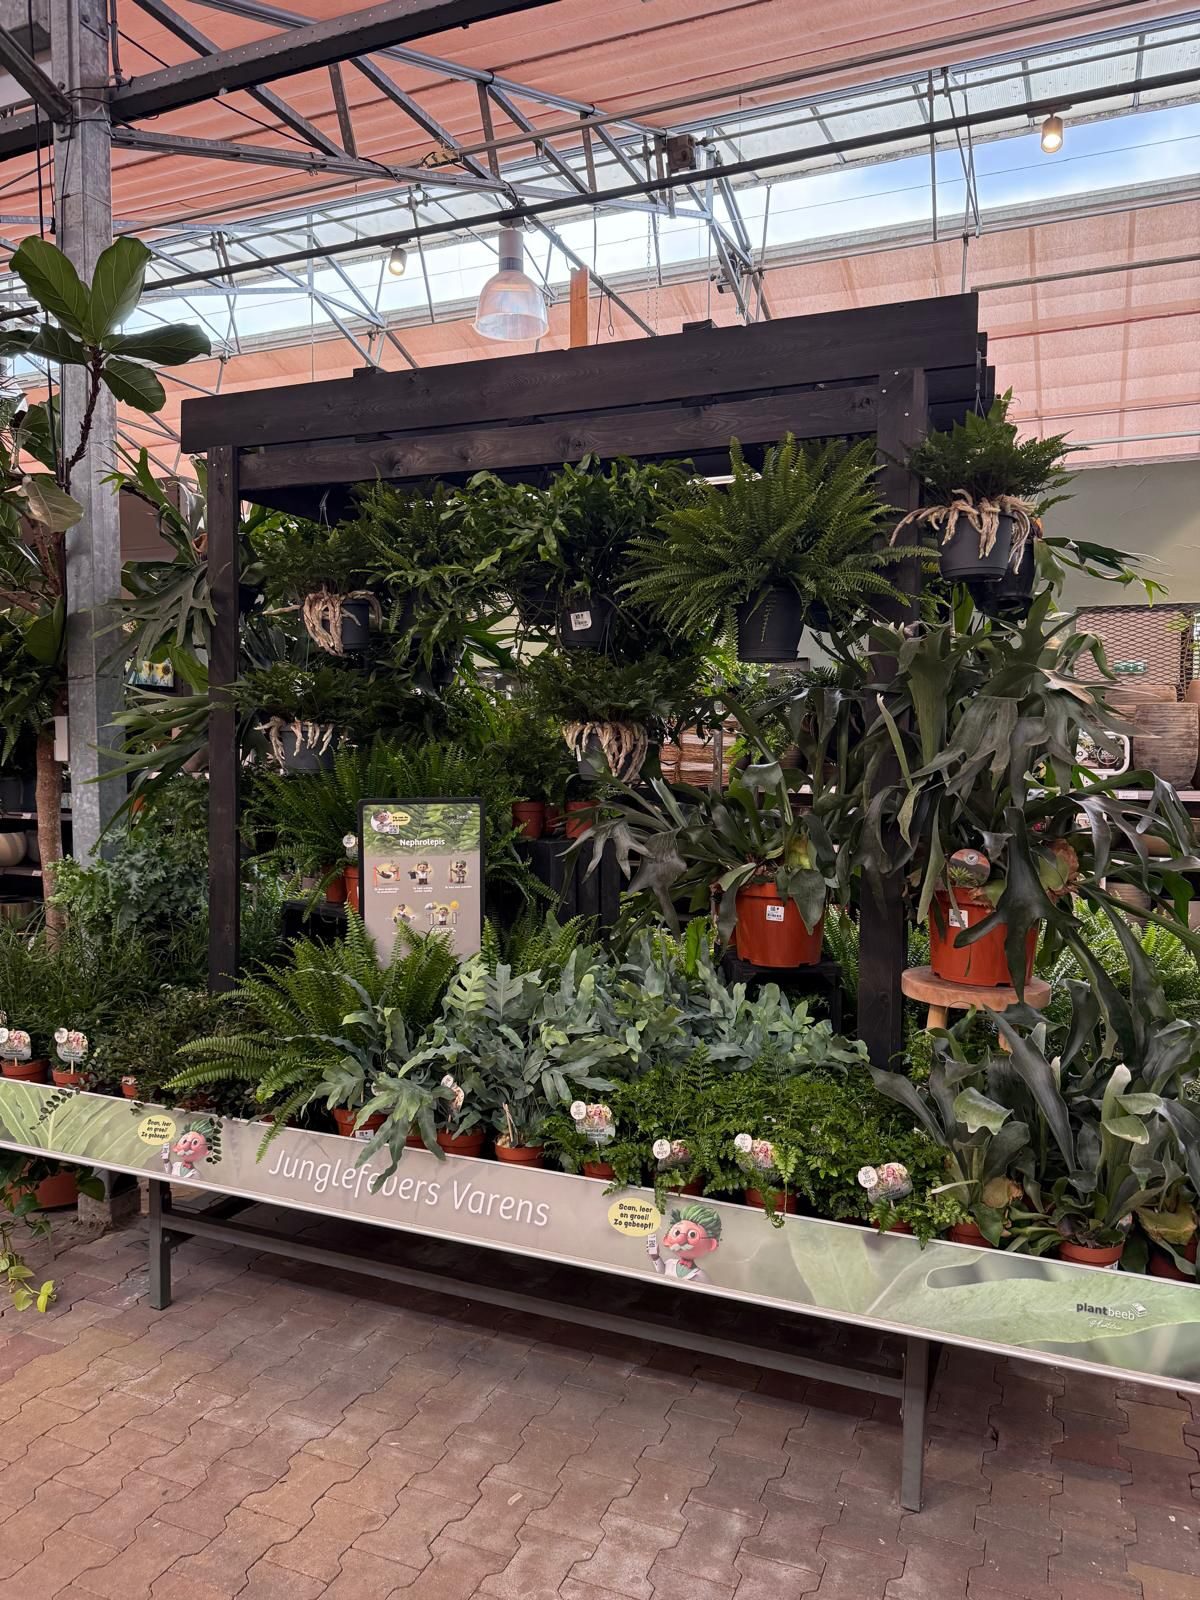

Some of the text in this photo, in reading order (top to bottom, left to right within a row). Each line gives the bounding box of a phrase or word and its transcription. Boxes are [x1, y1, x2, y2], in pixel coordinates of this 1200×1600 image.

[399, 837, 446, 848] Nephrolepis
[268, 1149, 550, 1227] Junglefevers Varens
[618, 1203, 653, 1213] Scan, leer
[629, 1213, 649, 1221] groei!
[613, 1218, 654, 1230] Zo gebeept!
[1076, 1302, 1135, 1321] plantbeeb
